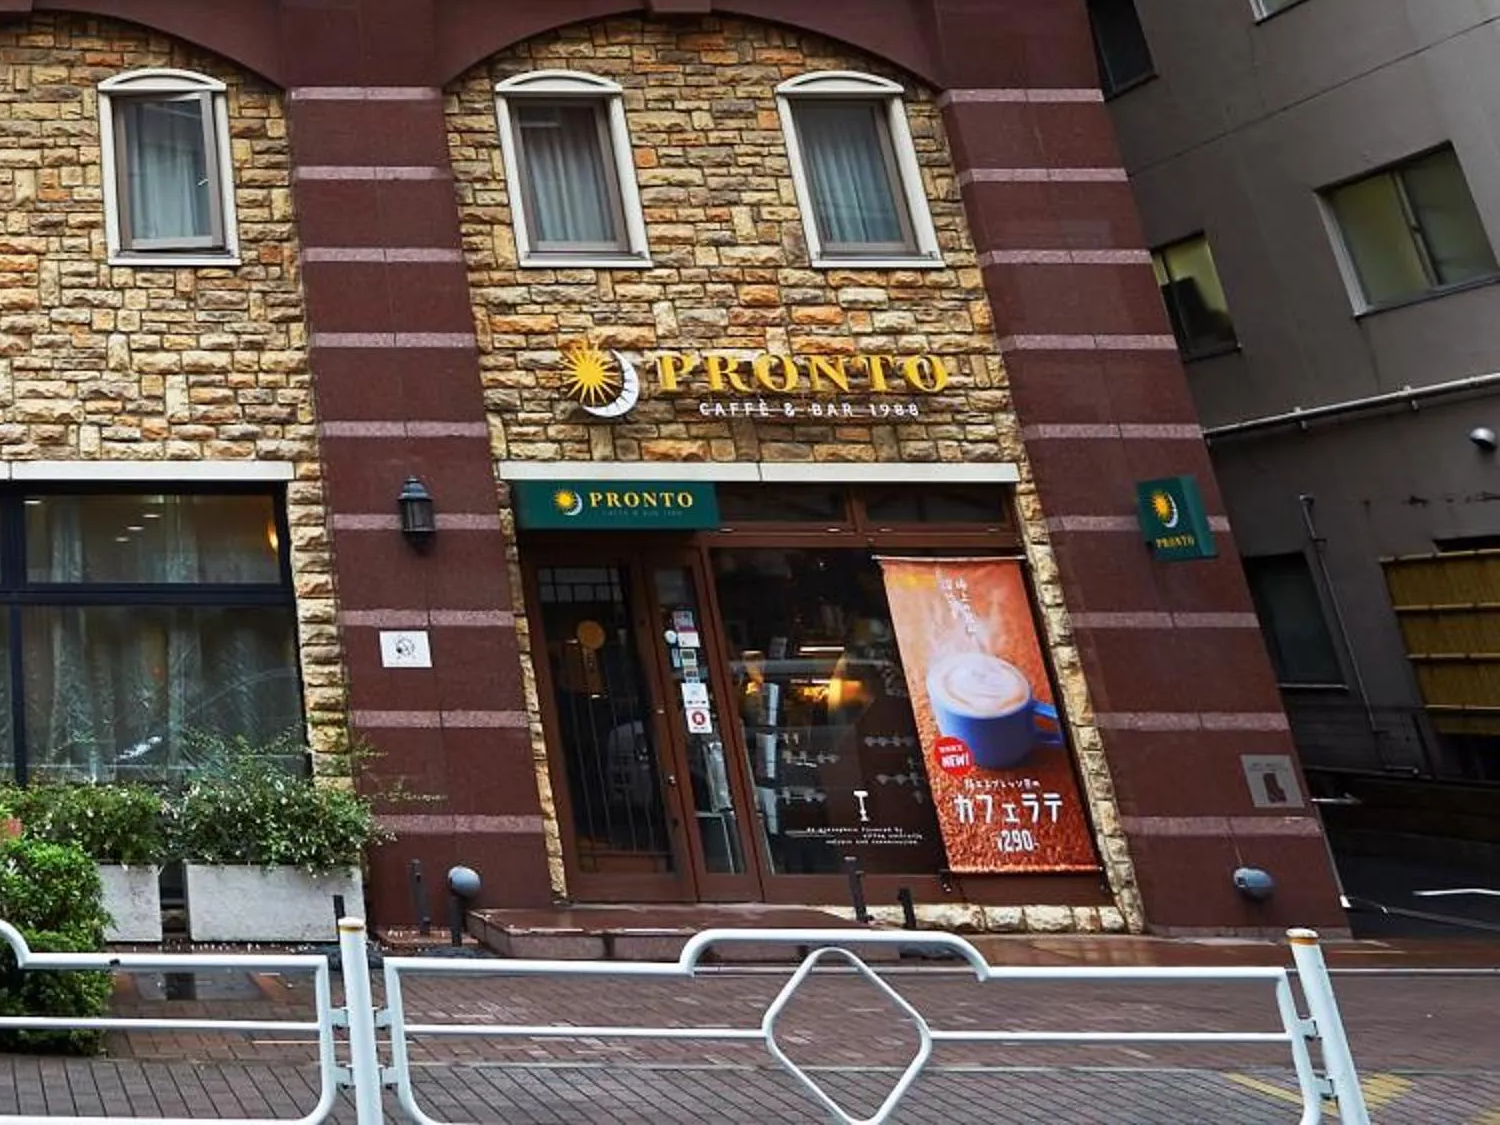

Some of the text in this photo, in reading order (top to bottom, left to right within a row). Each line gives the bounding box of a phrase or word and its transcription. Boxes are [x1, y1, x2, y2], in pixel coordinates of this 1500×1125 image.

[652, 352, 950, 394] PRONTO
[784, 402, 796, 417] &
[812, 402, 854, 417] BAR
[868, 402, 921, 417] 1988
[588, 491, 694, 509] PRONTO
[953, 792, 1063, 824] カフェラテ
